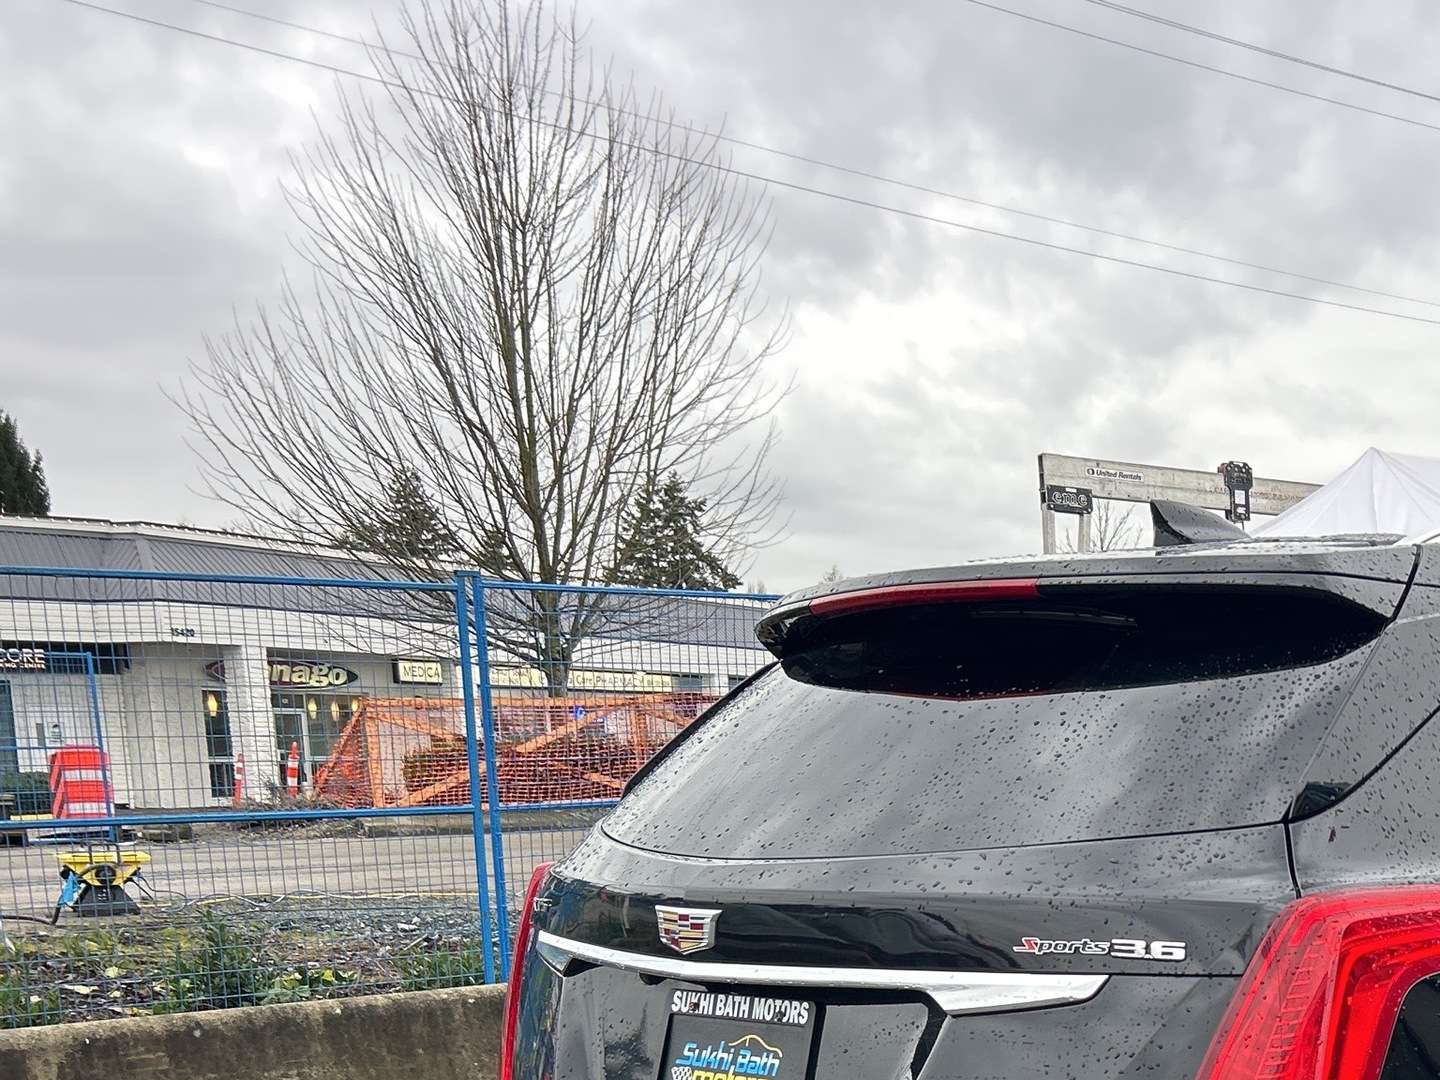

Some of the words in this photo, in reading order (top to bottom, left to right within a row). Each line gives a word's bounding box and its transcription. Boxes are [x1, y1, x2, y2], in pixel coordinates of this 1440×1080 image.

[1012, 937, 1111, 955] Sports
[1110, 938, 1187, 962] 3.6
[671, 990, 713, 1015] SUKHI
[715, 993, 750, 1019] BATH
[752, 997, 809, 1025] MOTORS
[675, 1040, 735, 1071] Sukhi
[734, 1047, 781, 1077] Bath
